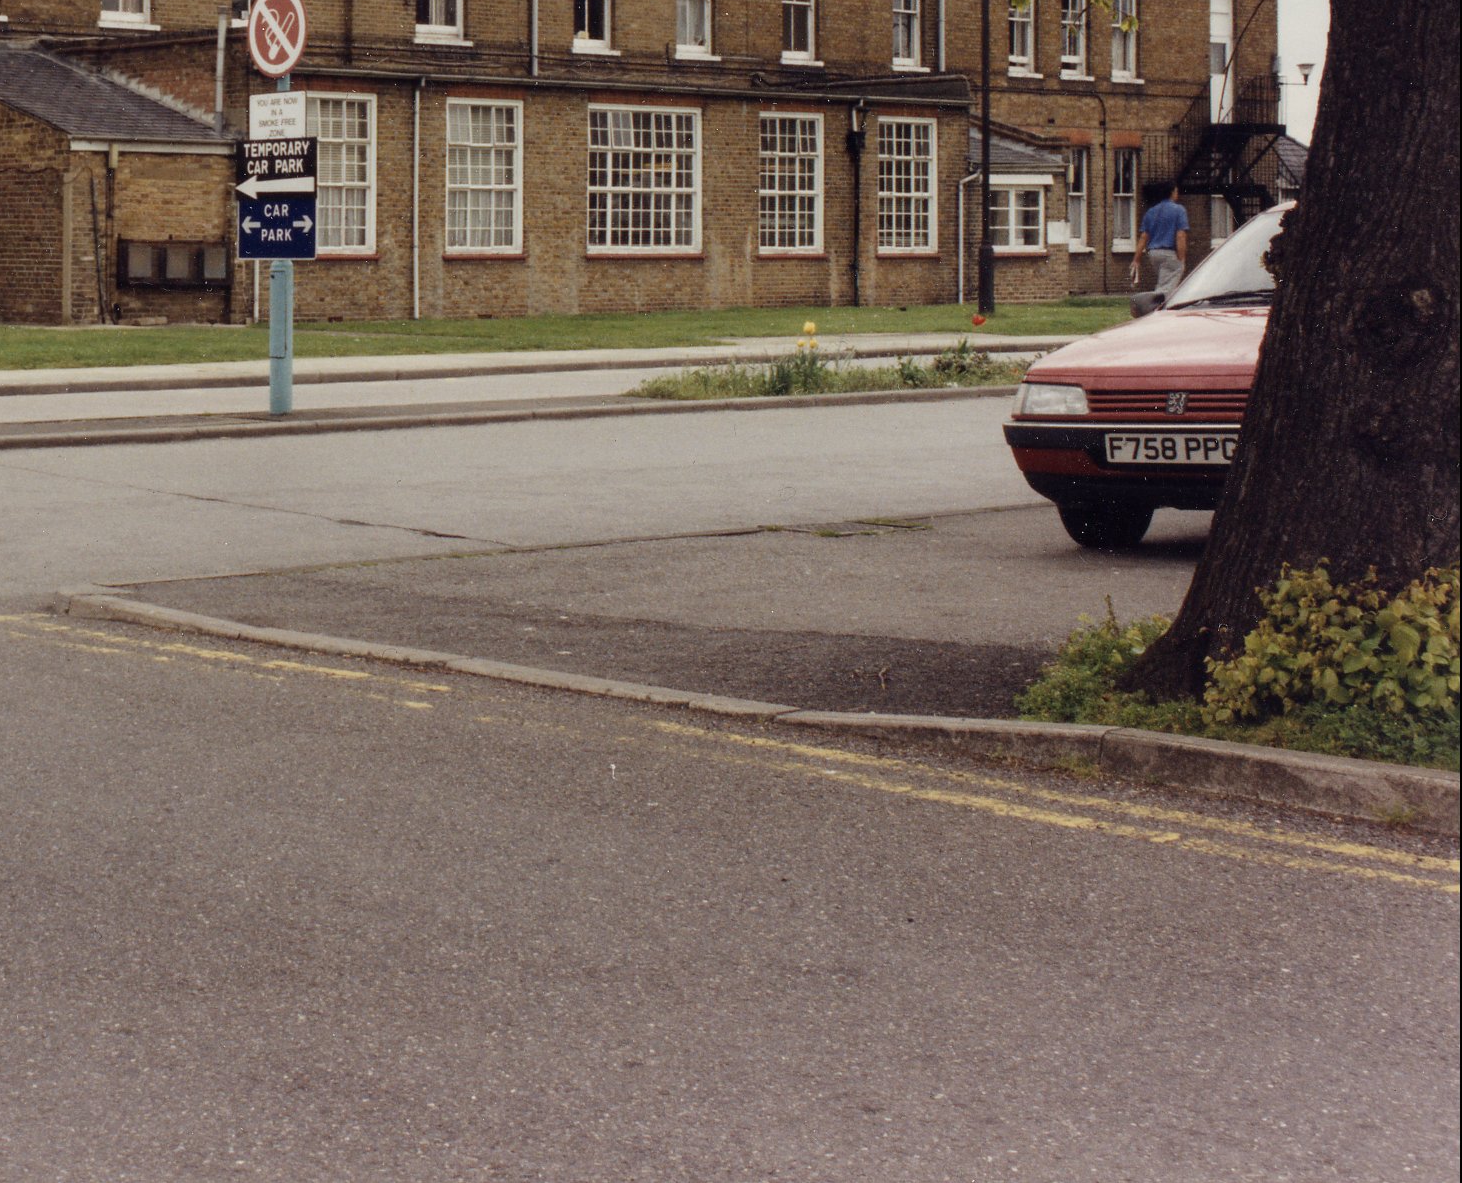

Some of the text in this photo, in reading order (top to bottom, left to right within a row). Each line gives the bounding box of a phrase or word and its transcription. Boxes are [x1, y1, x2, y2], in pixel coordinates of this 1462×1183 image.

[270, 98, 281, 106] ARE
[283, 97, 298, 105] NOW
[258, 118, 297, 127] SMOKE FREE
[269, 129, 285, 137] ZONE
[243, 141, 310, 158] TEMPORARY
[247, 158, 304, 175] CAR PARK
[264, 204, 289, 217] CAR
[261, 228, 292, 242] PARK
[1108, 437, 1177, 461] F758
